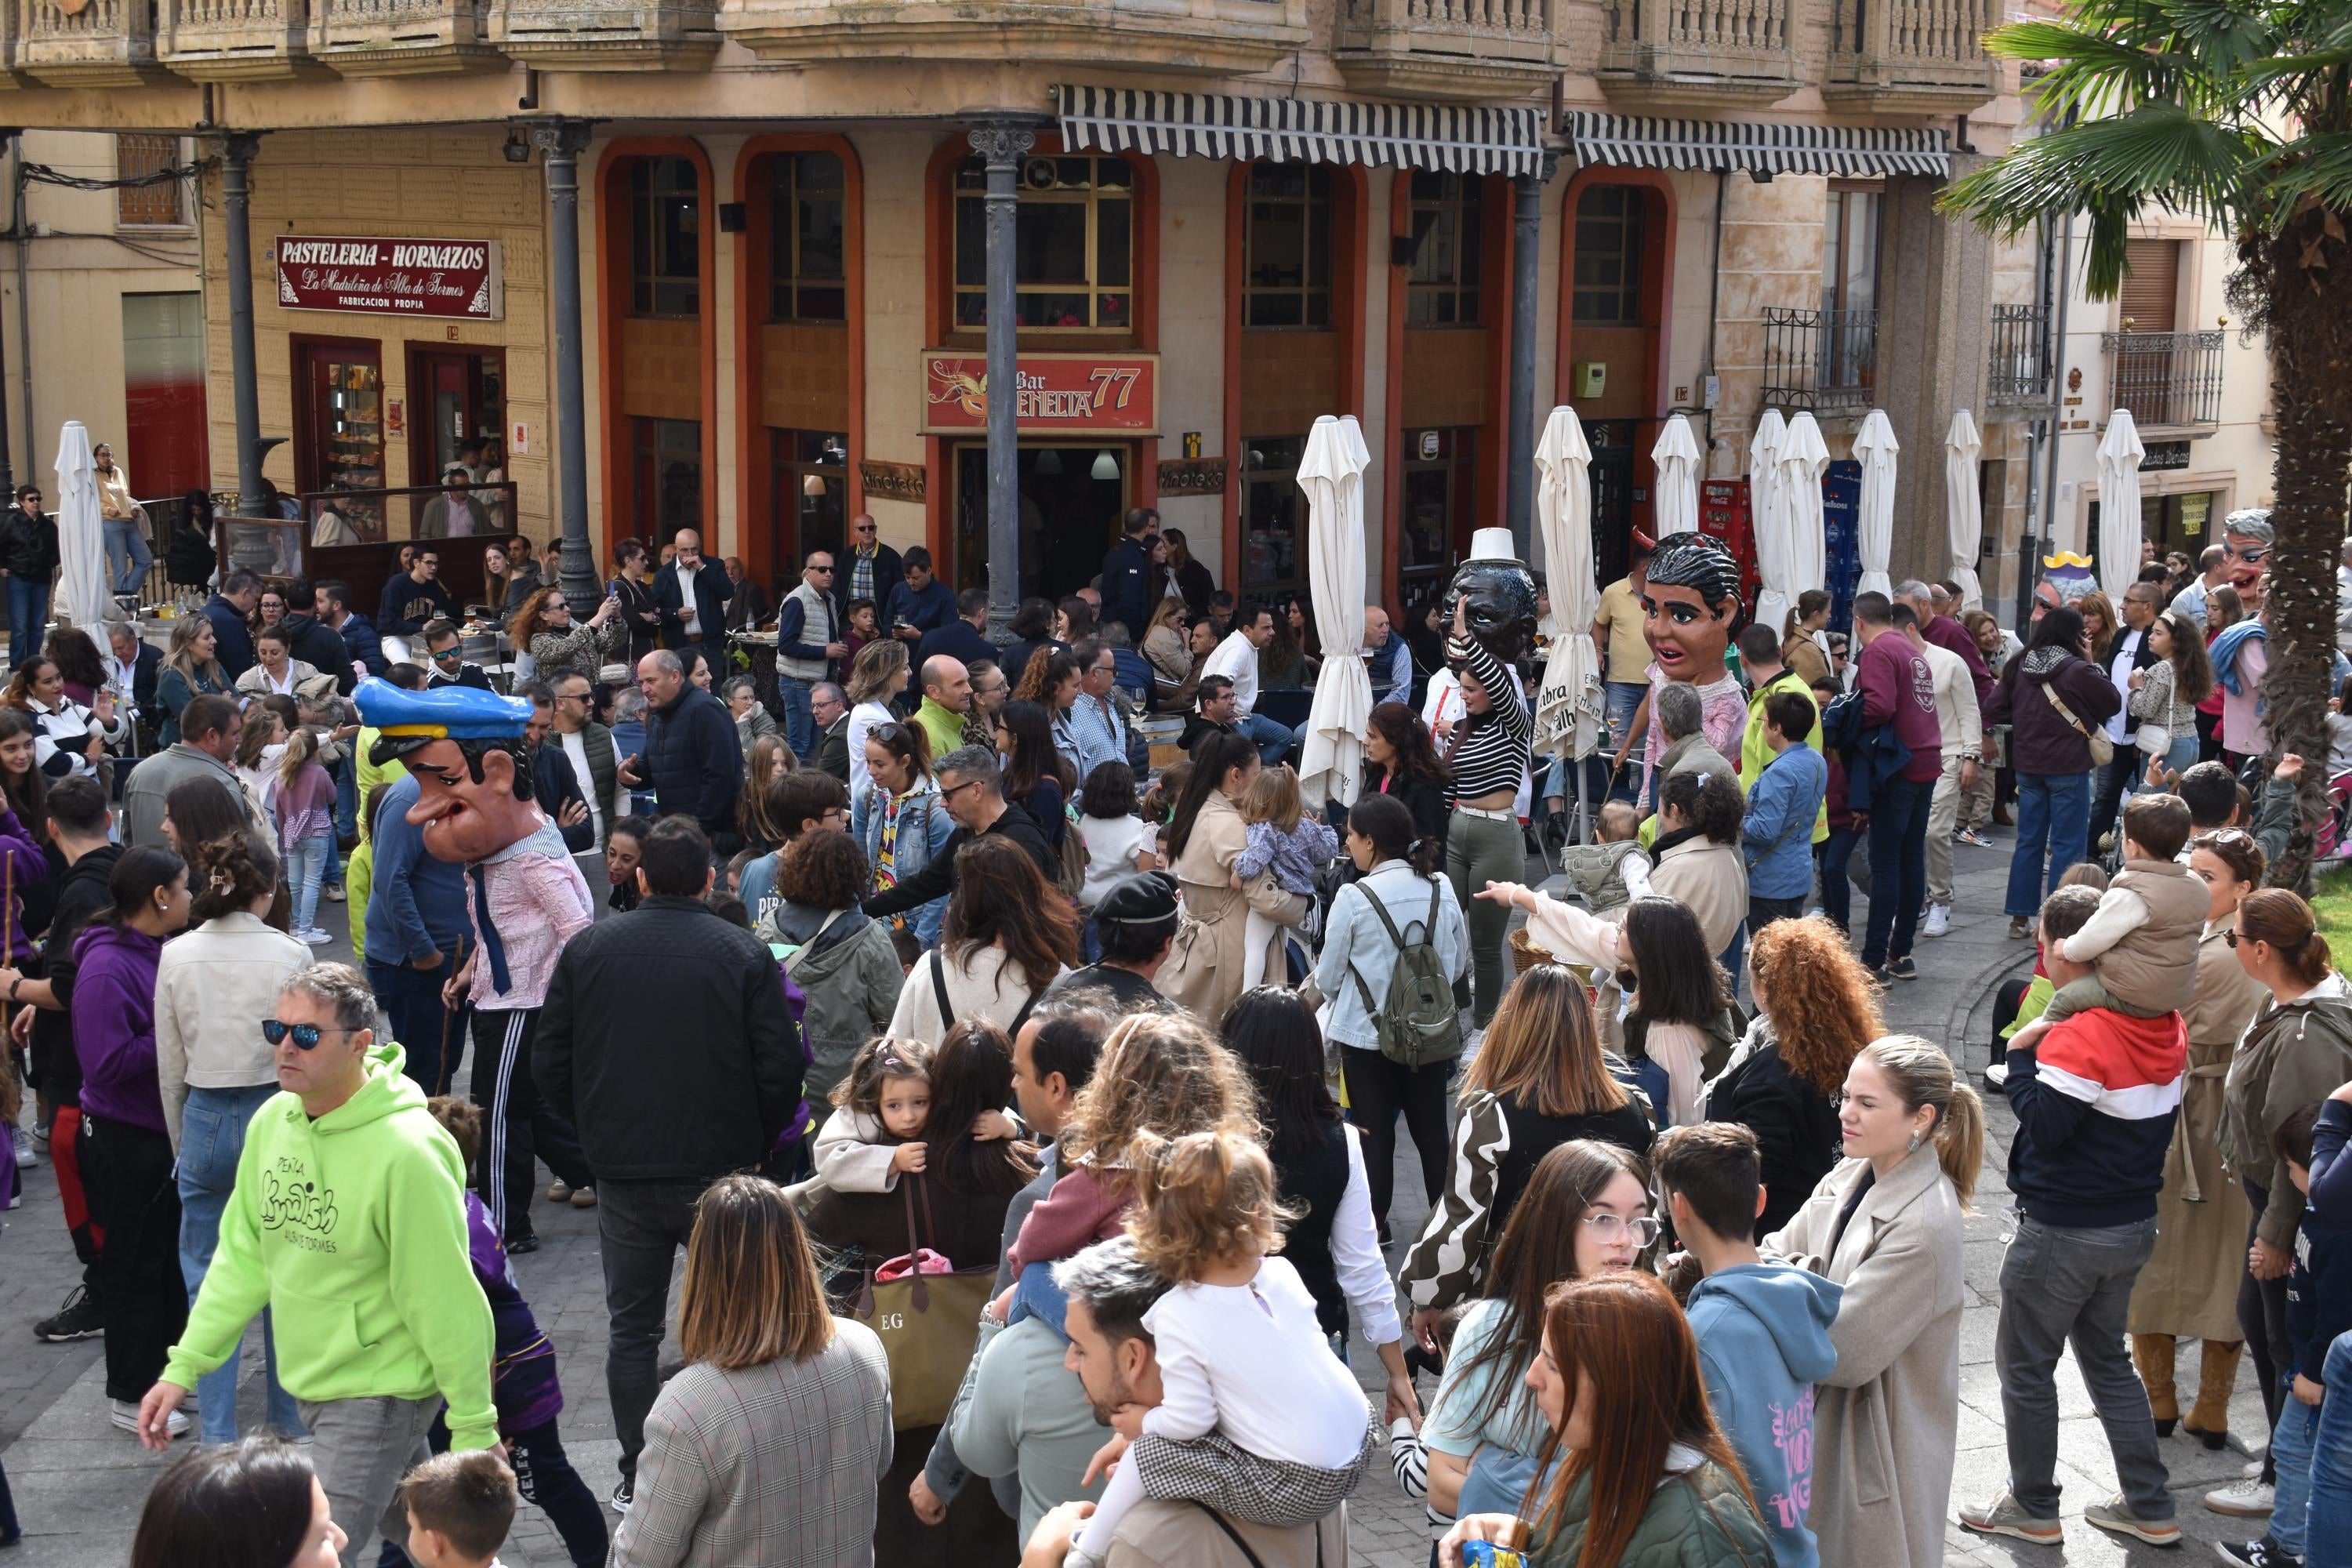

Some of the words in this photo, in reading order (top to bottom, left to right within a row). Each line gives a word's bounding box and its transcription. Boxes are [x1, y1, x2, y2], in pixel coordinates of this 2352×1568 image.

[281, 241, 378, 267] PASTELERIA
[392, 245, 485, 270] HORNAZOS
[300, 267, 320, 291] La
[321, 268, 370, 292] Madrileña
[371, 278, 383, 293] de
[383, 272, 411, 294] Alba
[412, 280, 424, 294] de
[426, 272, 465, 297] Tormes
[339, 296, 390, 307] FABRICACION
[394, 299, 424, 309] PROPIA
[1016, 371, 1046, 390] Bar
[1017, 390, 1093, 417] ENECIA
[1091, 368, 1142, 408] 77
[277, 1156, 305, 1177] PEÑA
[880, 1312, 903, 1330] EG
[516, 1459, 536, 1500] KELE
